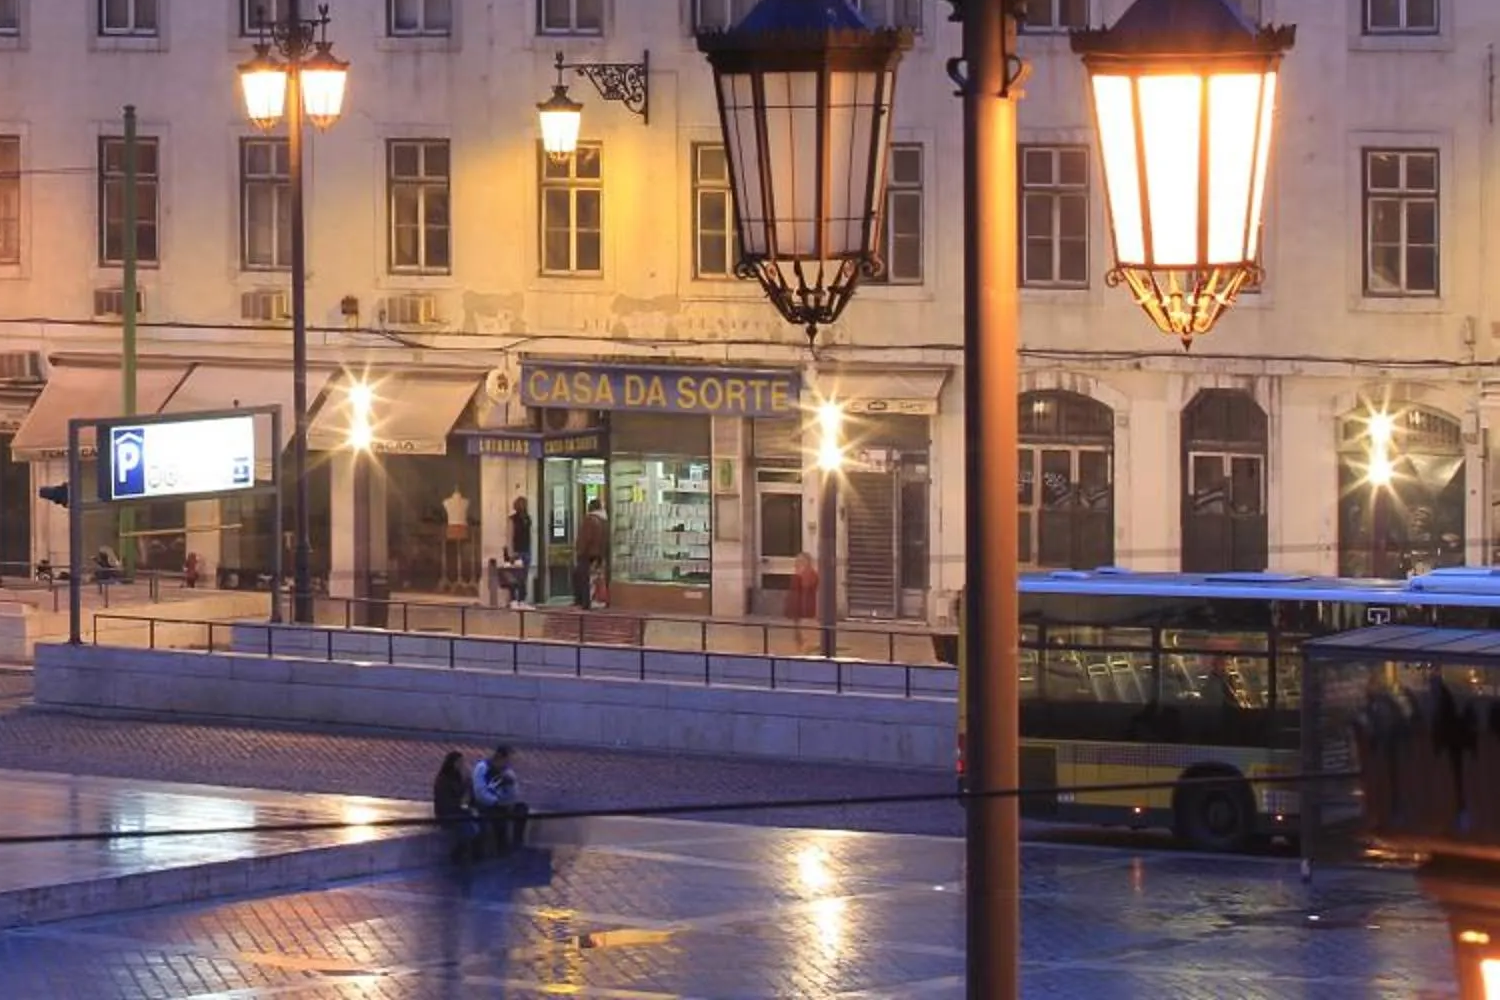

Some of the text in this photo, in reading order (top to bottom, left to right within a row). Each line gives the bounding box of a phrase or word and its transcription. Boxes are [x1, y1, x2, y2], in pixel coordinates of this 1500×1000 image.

[527, 369, 791, 412] CASA DA SORTE
[117, 441, 140, 484] P
